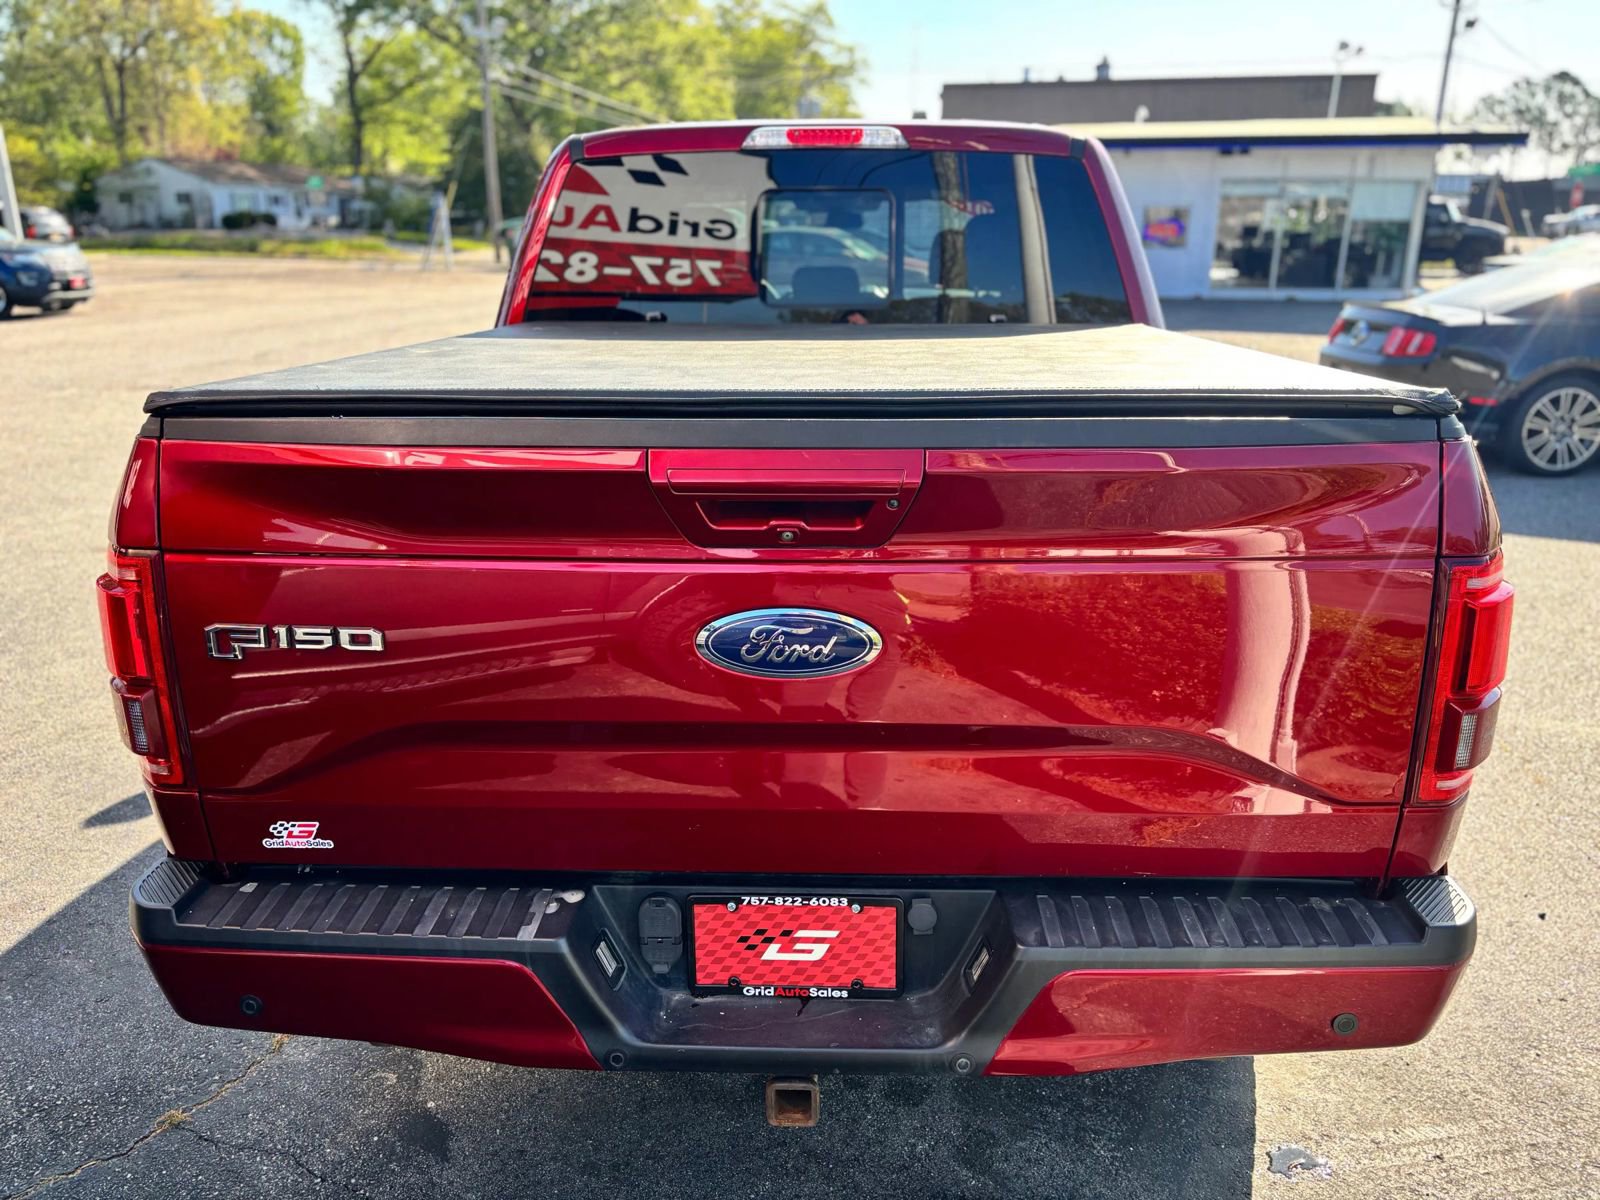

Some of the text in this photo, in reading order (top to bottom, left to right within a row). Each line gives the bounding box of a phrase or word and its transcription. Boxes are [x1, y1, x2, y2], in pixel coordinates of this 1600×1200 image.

[740, 624, 837, 663] Ford
[264, 839, 332, 847] GridAutoSales
[741, 896, 848, 907] 757-822-6083
[742, 986, 849, 998] GridAutoSales
